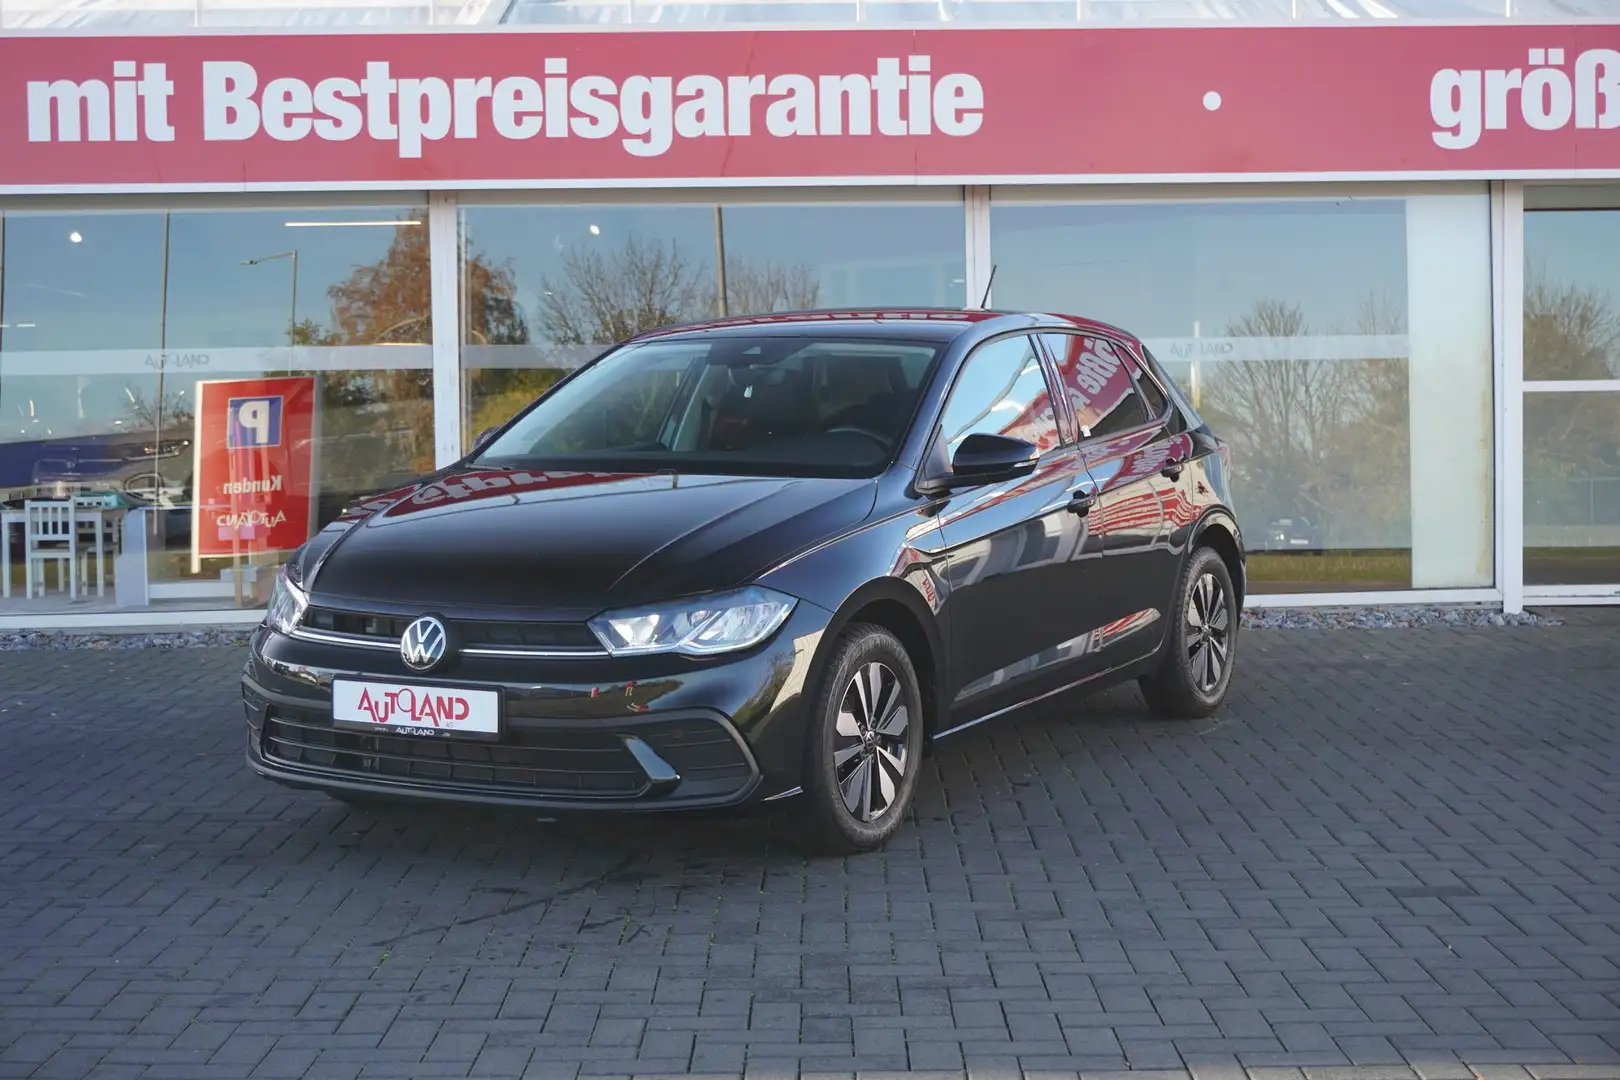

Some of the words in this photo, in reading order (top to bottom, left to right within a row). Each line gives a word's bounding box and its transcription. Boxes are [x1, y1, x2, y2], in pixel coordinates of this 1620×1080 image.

[26, 60, 176, 142] mit
[203, 54, 985, 159] Bestpreisgarantie
[357, 686, 470, 728] AUTOLAND
